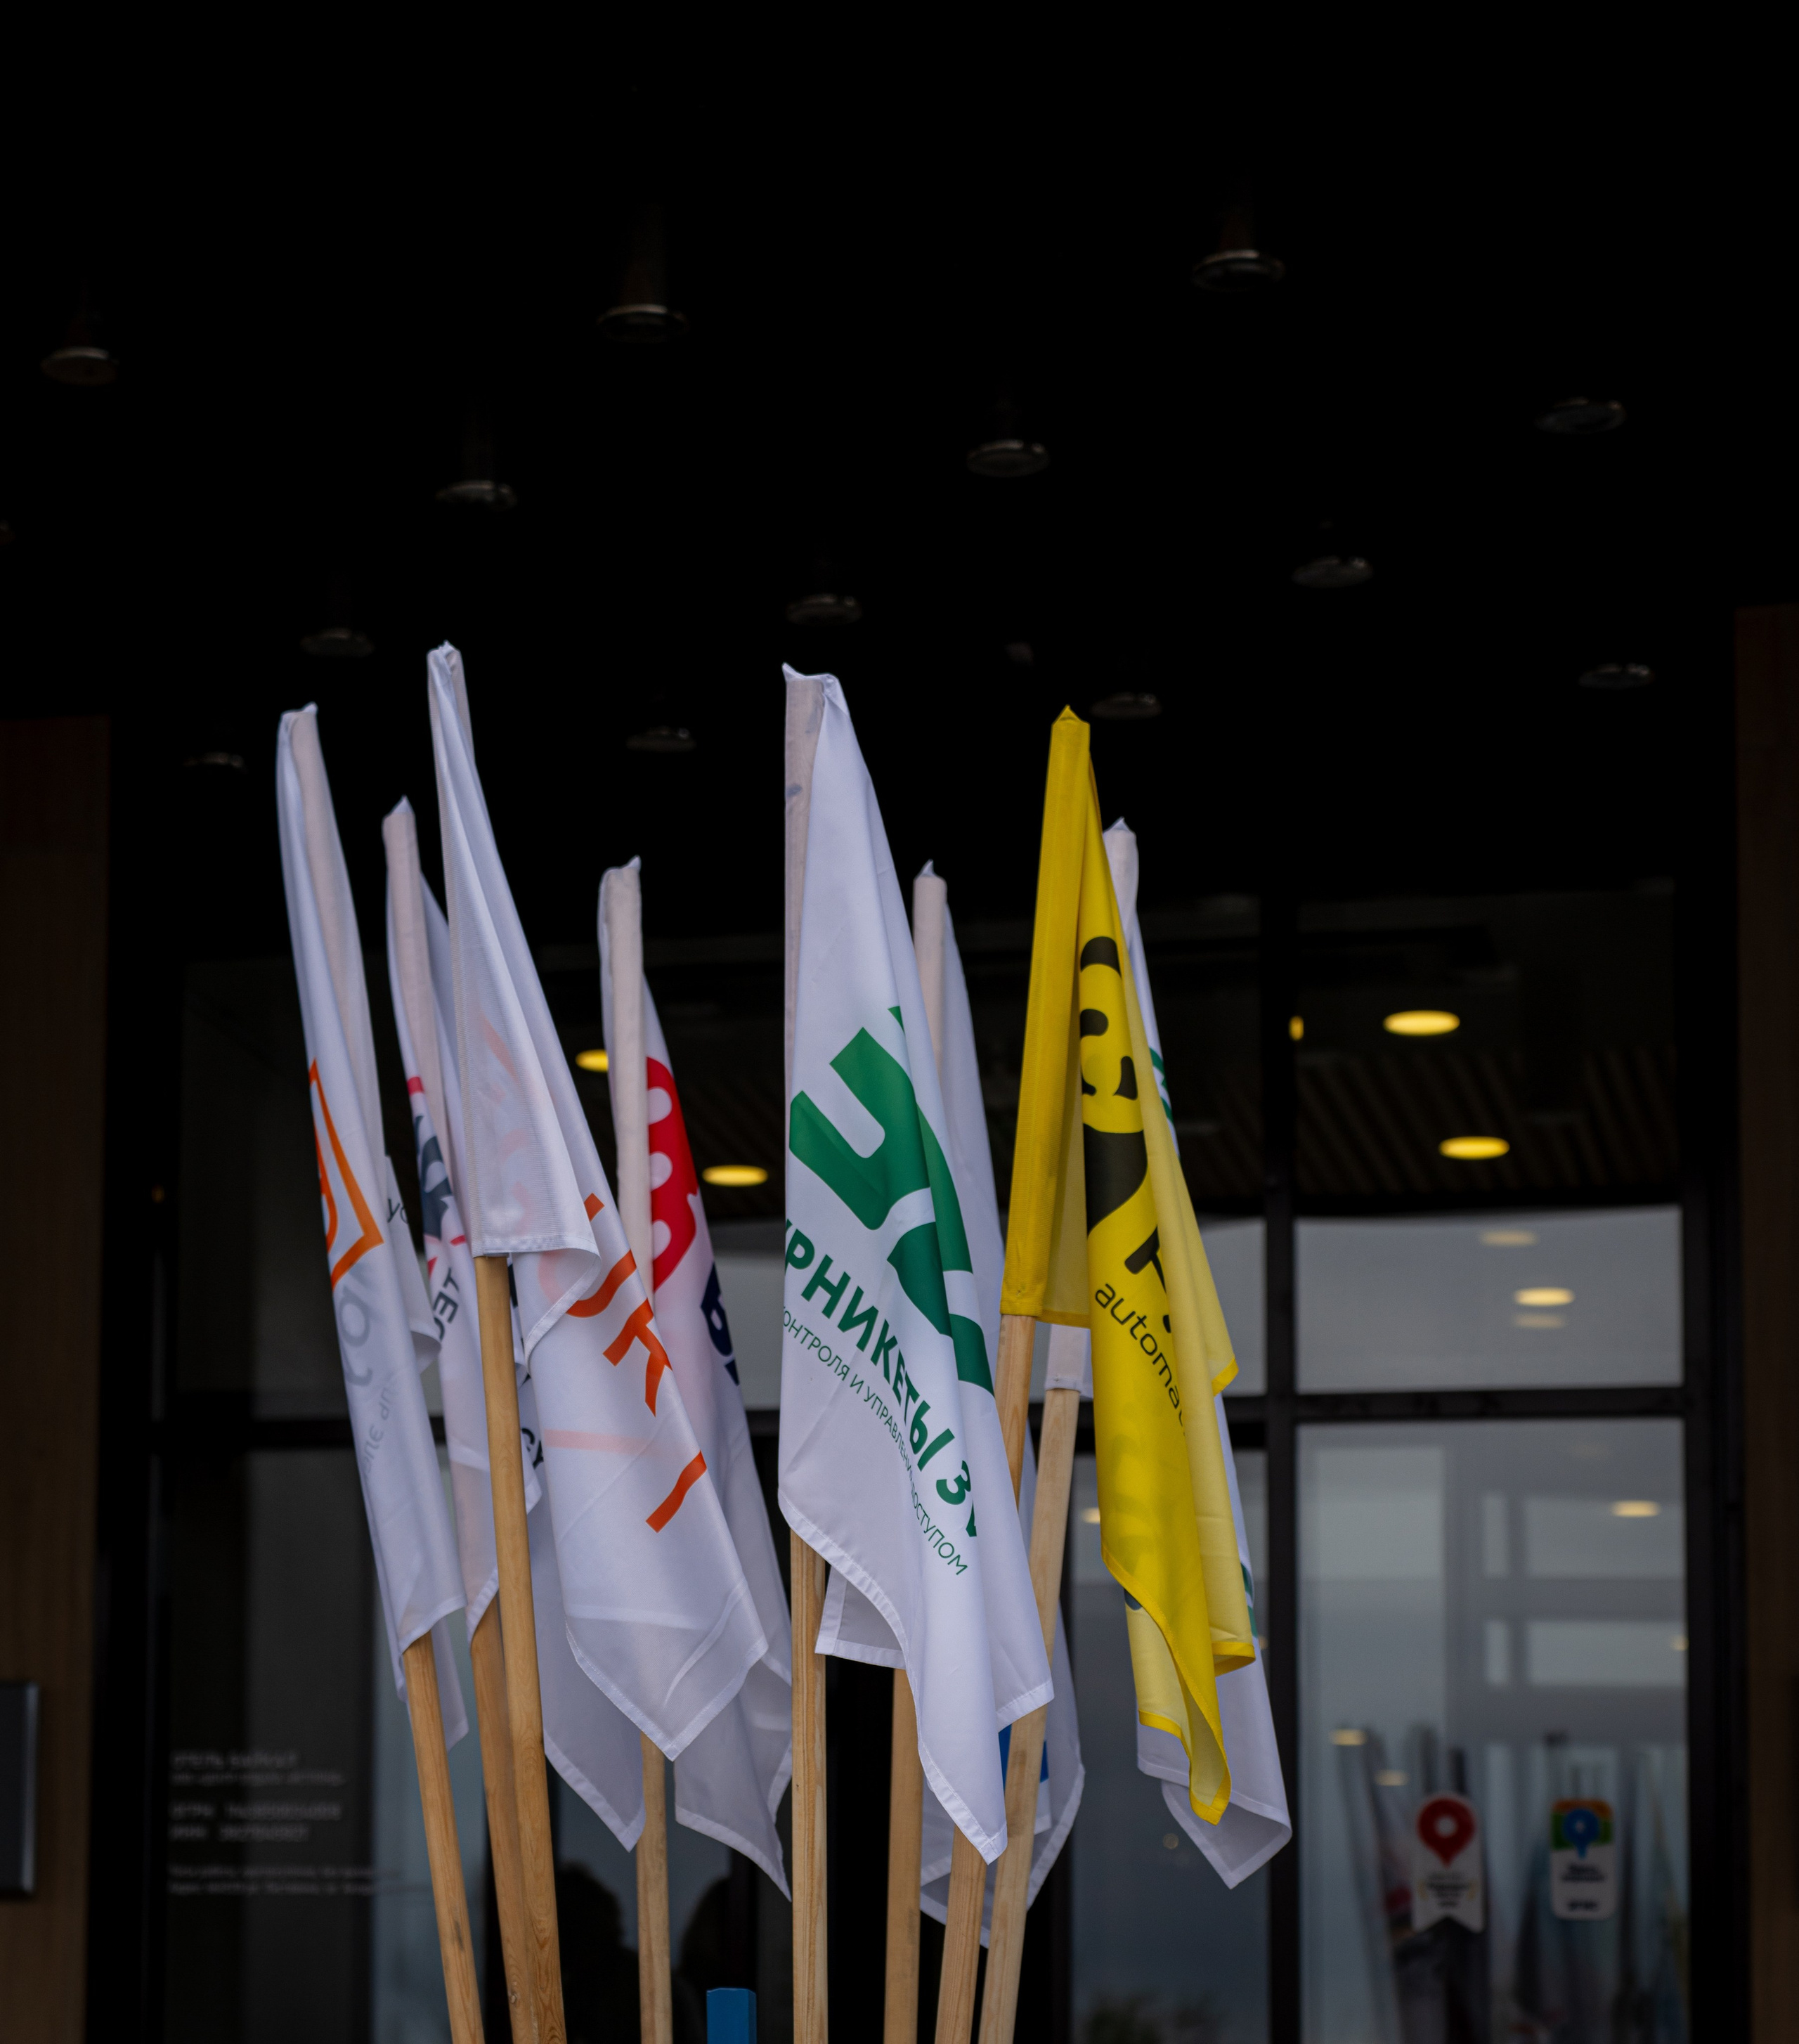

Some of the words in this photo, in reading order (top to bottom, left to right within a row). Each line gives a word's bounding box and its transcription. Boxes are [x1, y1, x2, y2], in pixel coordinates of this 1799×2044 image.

[784, 1306, 850, 1381] ОНТРОЛЯ
[850, 1374, 864, 1394] И
[1095, 1283, 1184, 1428] automa
